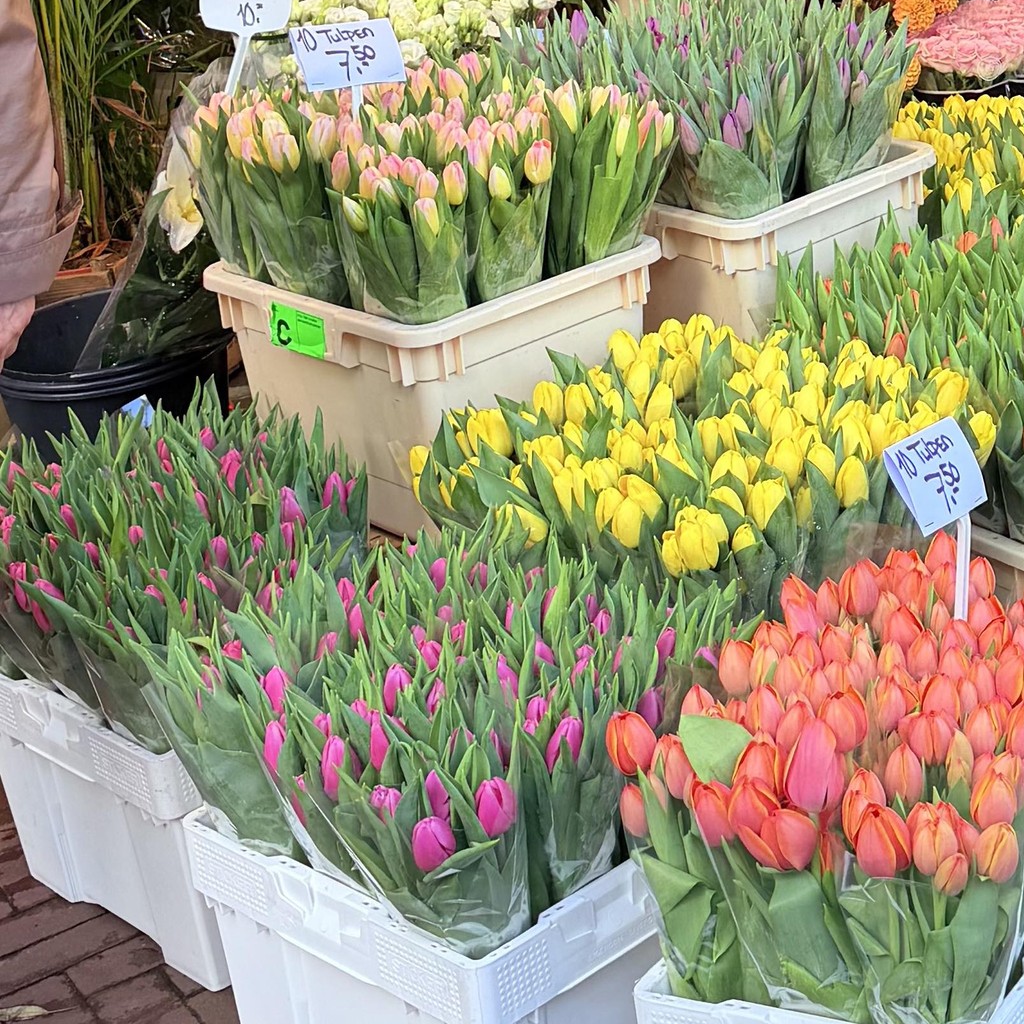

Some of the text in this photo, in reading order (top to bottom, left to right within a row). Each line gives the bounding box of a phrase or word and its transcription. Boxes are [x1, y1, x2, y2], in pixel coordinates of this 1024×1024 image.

[297, 29, 317, 53] 10
[276, 319, 292, 346] C
[898, 452, 916, 479] 10
